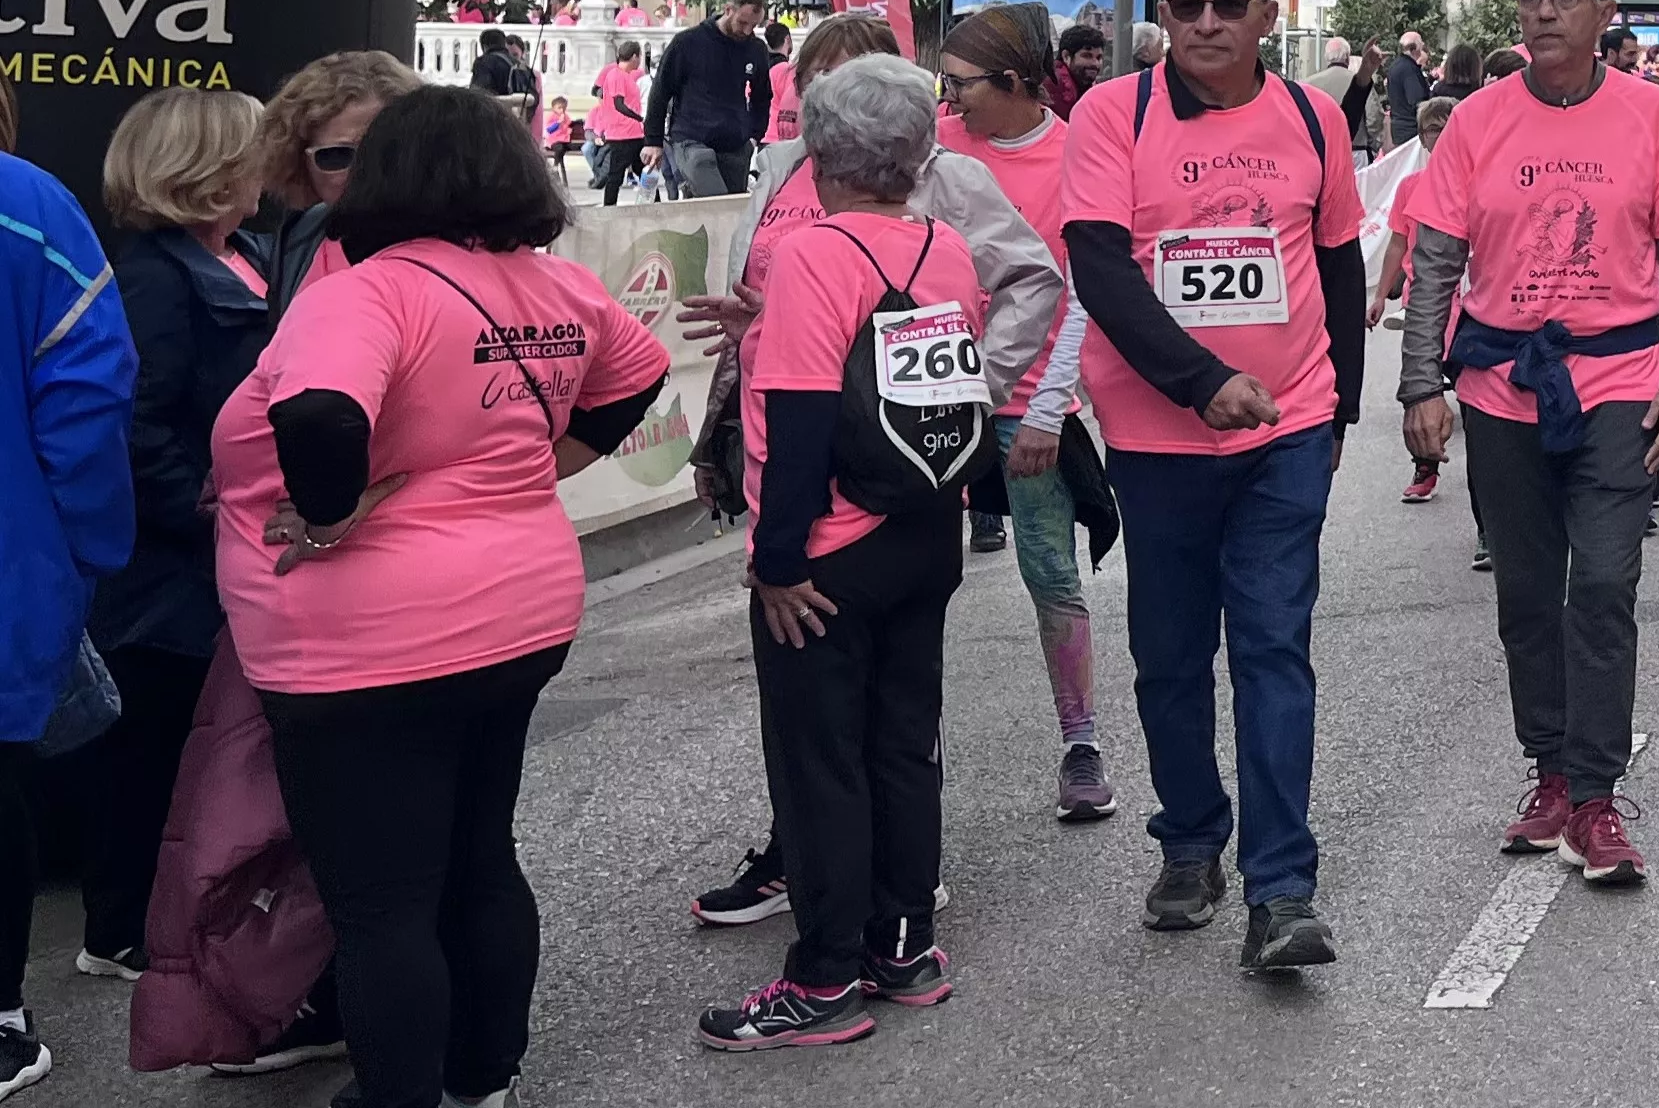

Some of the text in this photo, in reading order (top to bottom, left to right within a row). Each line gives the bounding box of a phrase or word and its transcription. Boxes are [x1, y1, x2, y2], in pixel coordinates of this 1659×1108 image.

[1212, 152, 1277, 170] CÁNCER
[1545, 158, 1604, 174] CÁNCER
[1247, 170, 1290, 182] HUESCA
[1574, 174, 1614, 185] HUESCA
[1205, 239, 1240, 248] HUESCA
[1168, 248, 1215, 260] CONTRA
[1217, 247, 1231, 259] EL
[1181, 262, 1264, 302] 520
[891, 325, 946, 342] CONTRA
[947, 321, 962, 333] EL
[488, 343, 578, 361] SUPMERCADOS
[891, 338, 982, 383] 260
